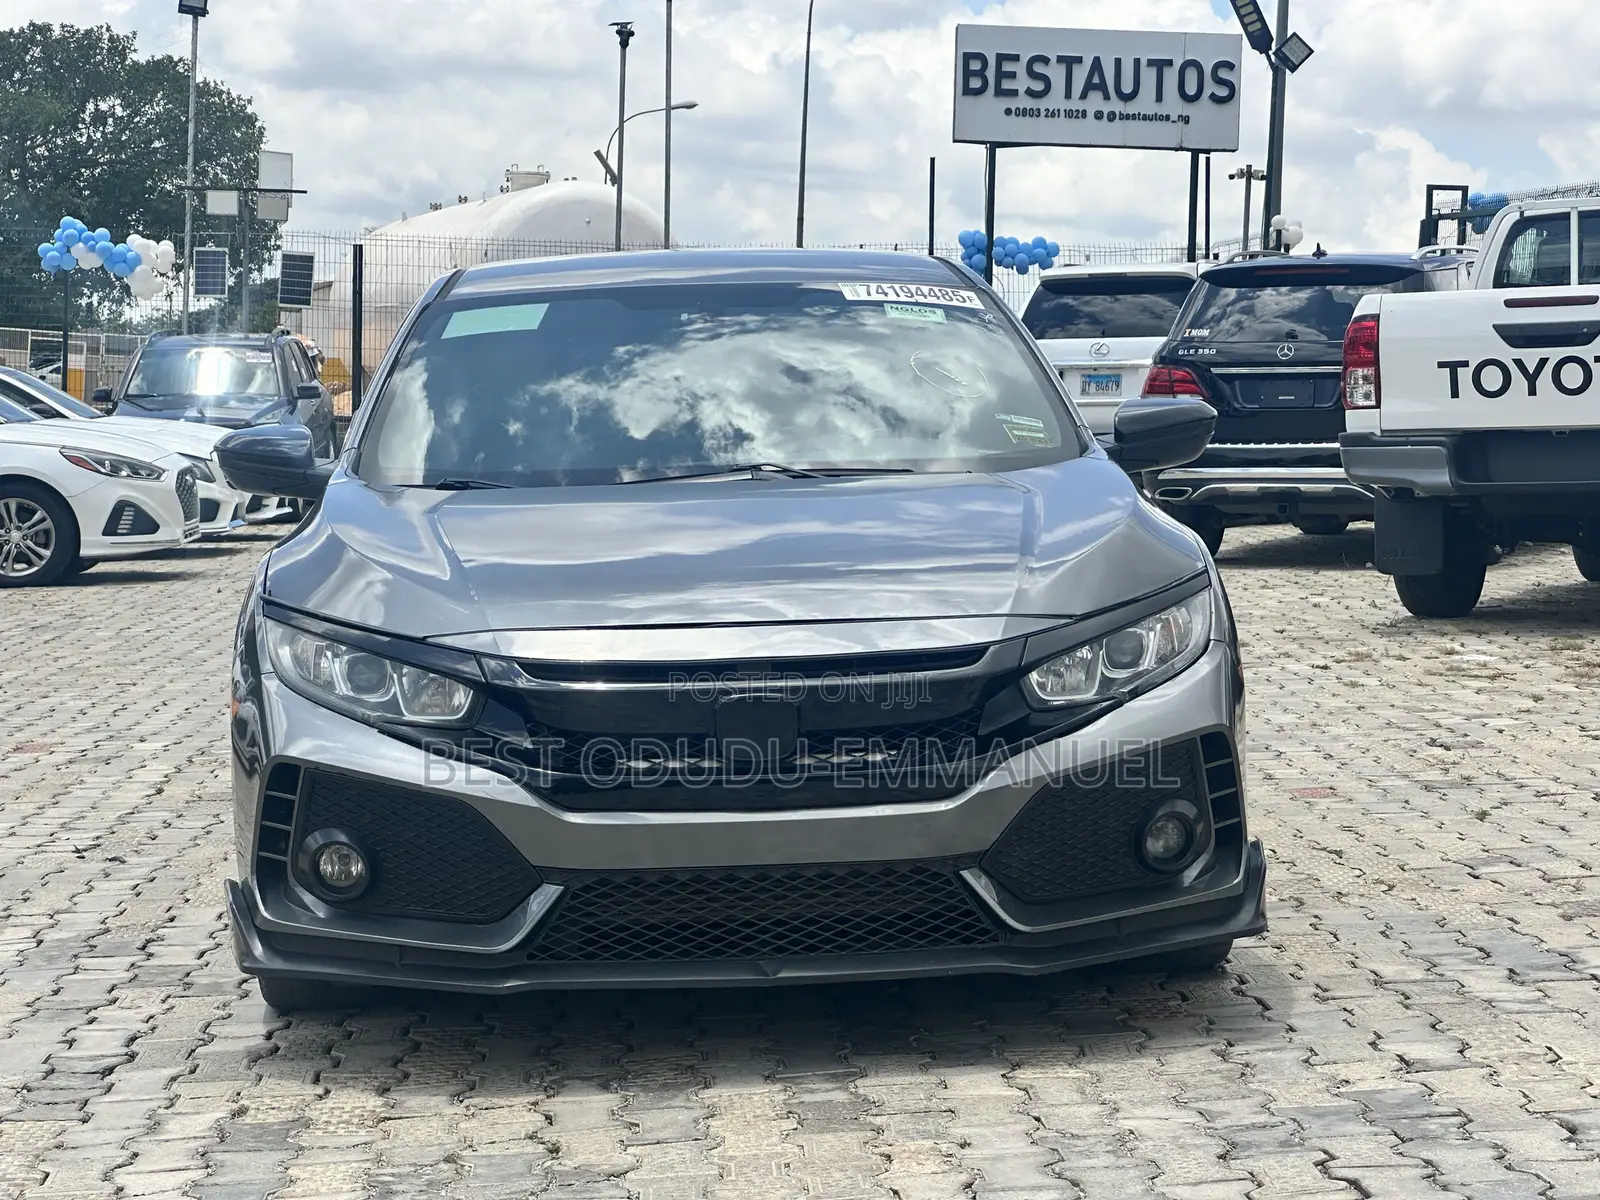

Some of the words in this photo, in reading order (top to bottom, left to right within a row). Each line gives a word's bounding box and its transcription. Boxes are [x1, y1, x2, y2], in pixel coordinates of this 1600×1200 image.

[961, 51, 1237, 104] BESTAUTOS
[1014, 106, 1042, 119] 0803
[1043, 107, 1061, 119] 261
[1063, 108, 1088, 120] 1028
[1095, 380, 1120, 392] 84679
[1436, 354, 1600, 399] TOYO
